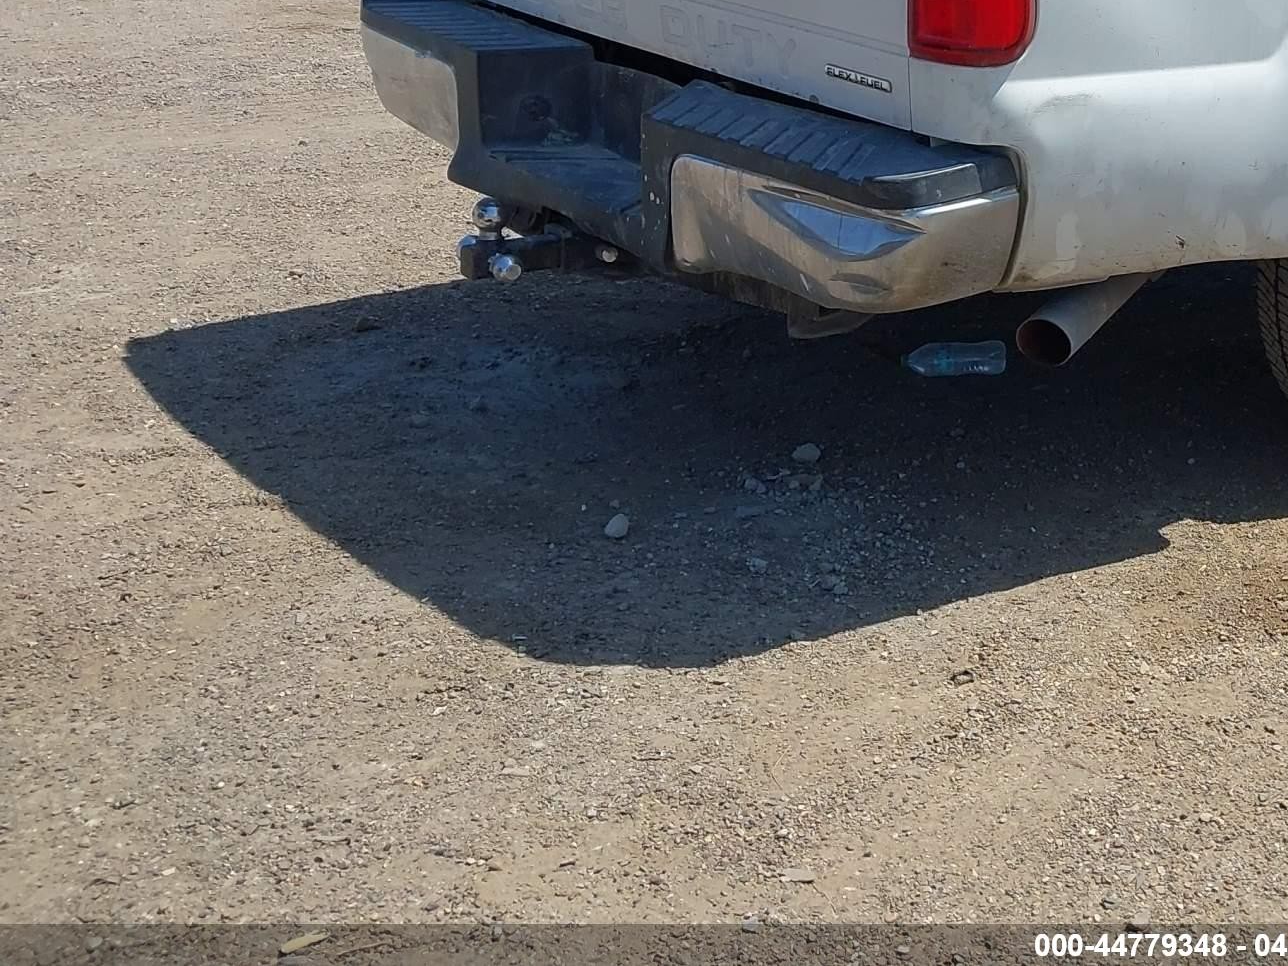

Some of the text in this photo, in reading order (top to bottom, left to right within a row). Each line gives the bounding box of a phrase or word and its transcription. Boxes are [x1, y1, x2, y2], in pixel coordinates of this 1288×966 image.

[660, 4, 797, 76] DUTY
[826, 66, 889, 92] FLEX FUEL
